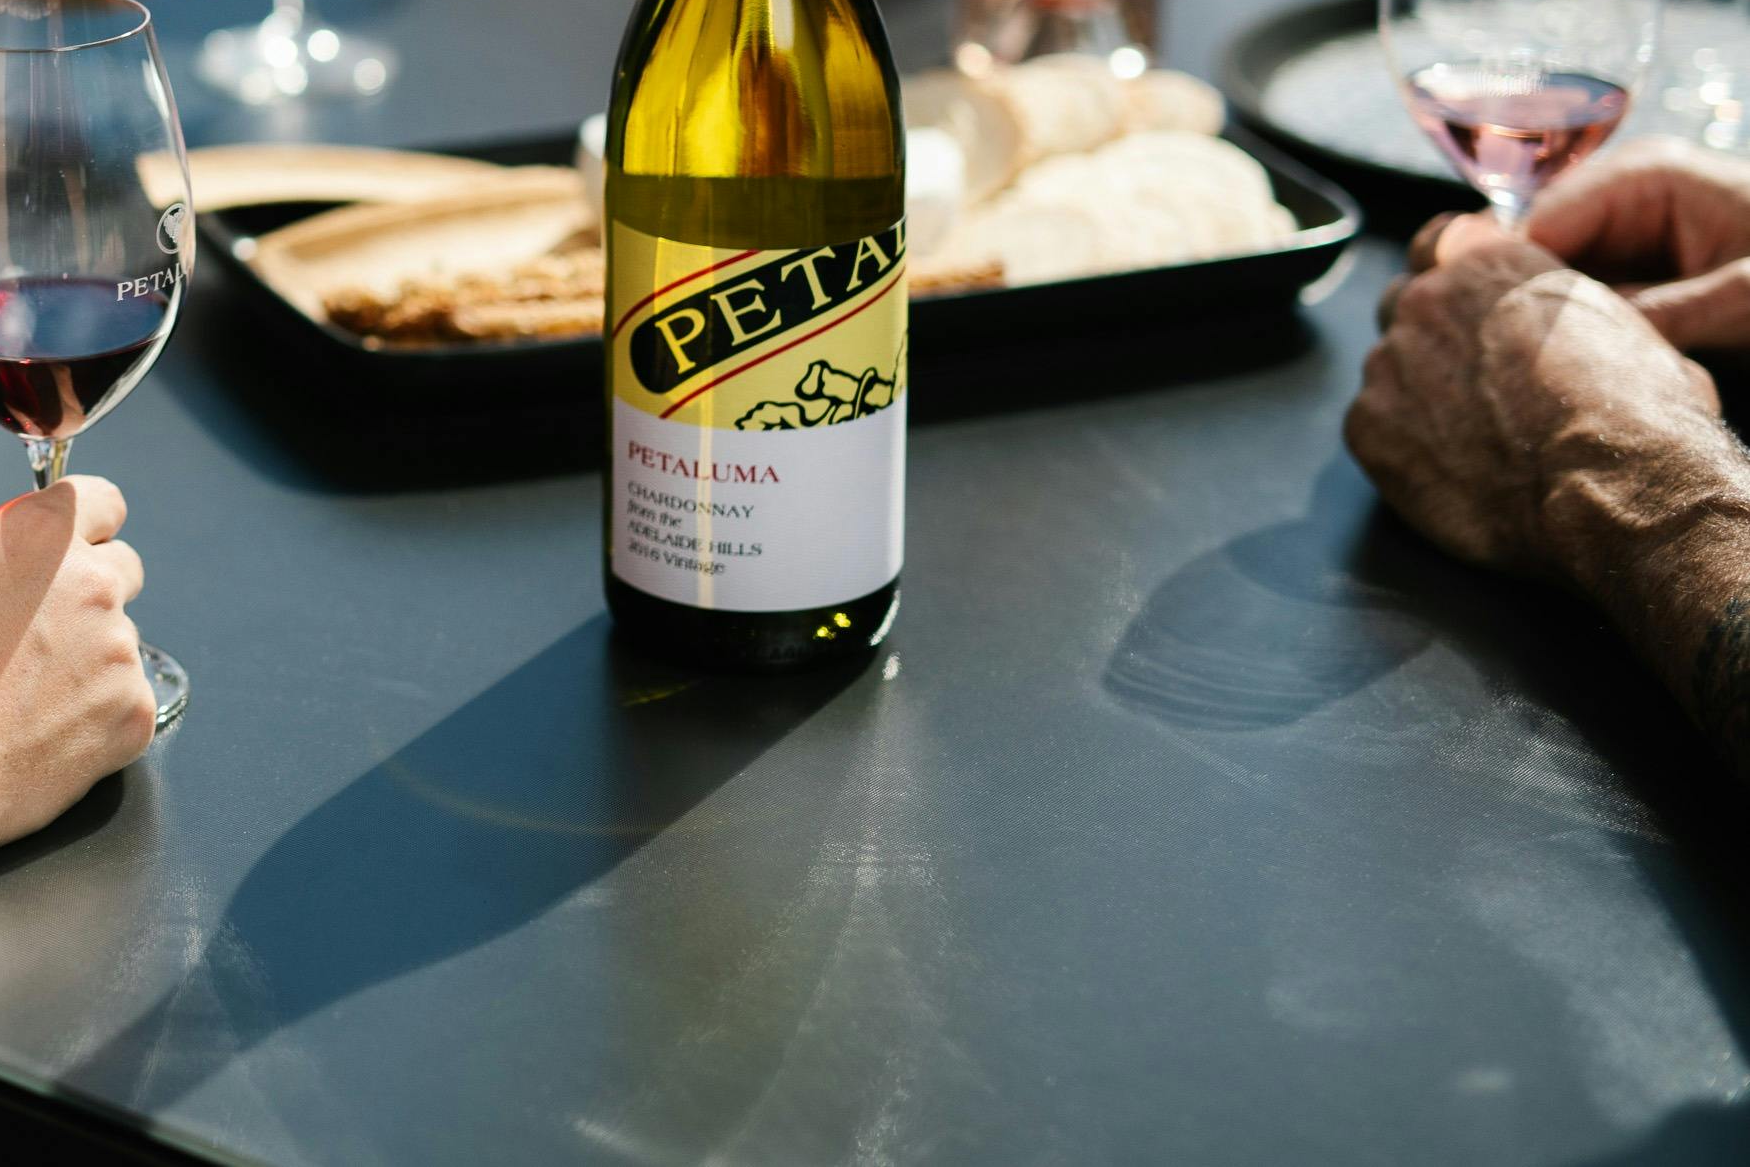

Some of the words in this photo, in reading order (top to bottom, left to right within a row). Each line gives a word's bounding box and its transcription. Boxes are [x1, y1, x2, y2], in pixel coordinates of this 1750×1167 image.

[654, 221, 906, 375] PETAL
[627, 440, 780, 483] PETALUMA
[627, 480, 755, 519] CHARDONNAY
[627, 519, 704, 552] ADELAIDE
[709, 540, 762, 556] HILLS
[659, 512, 682, 529] the
[662, 551, 726, 575] Vintage
